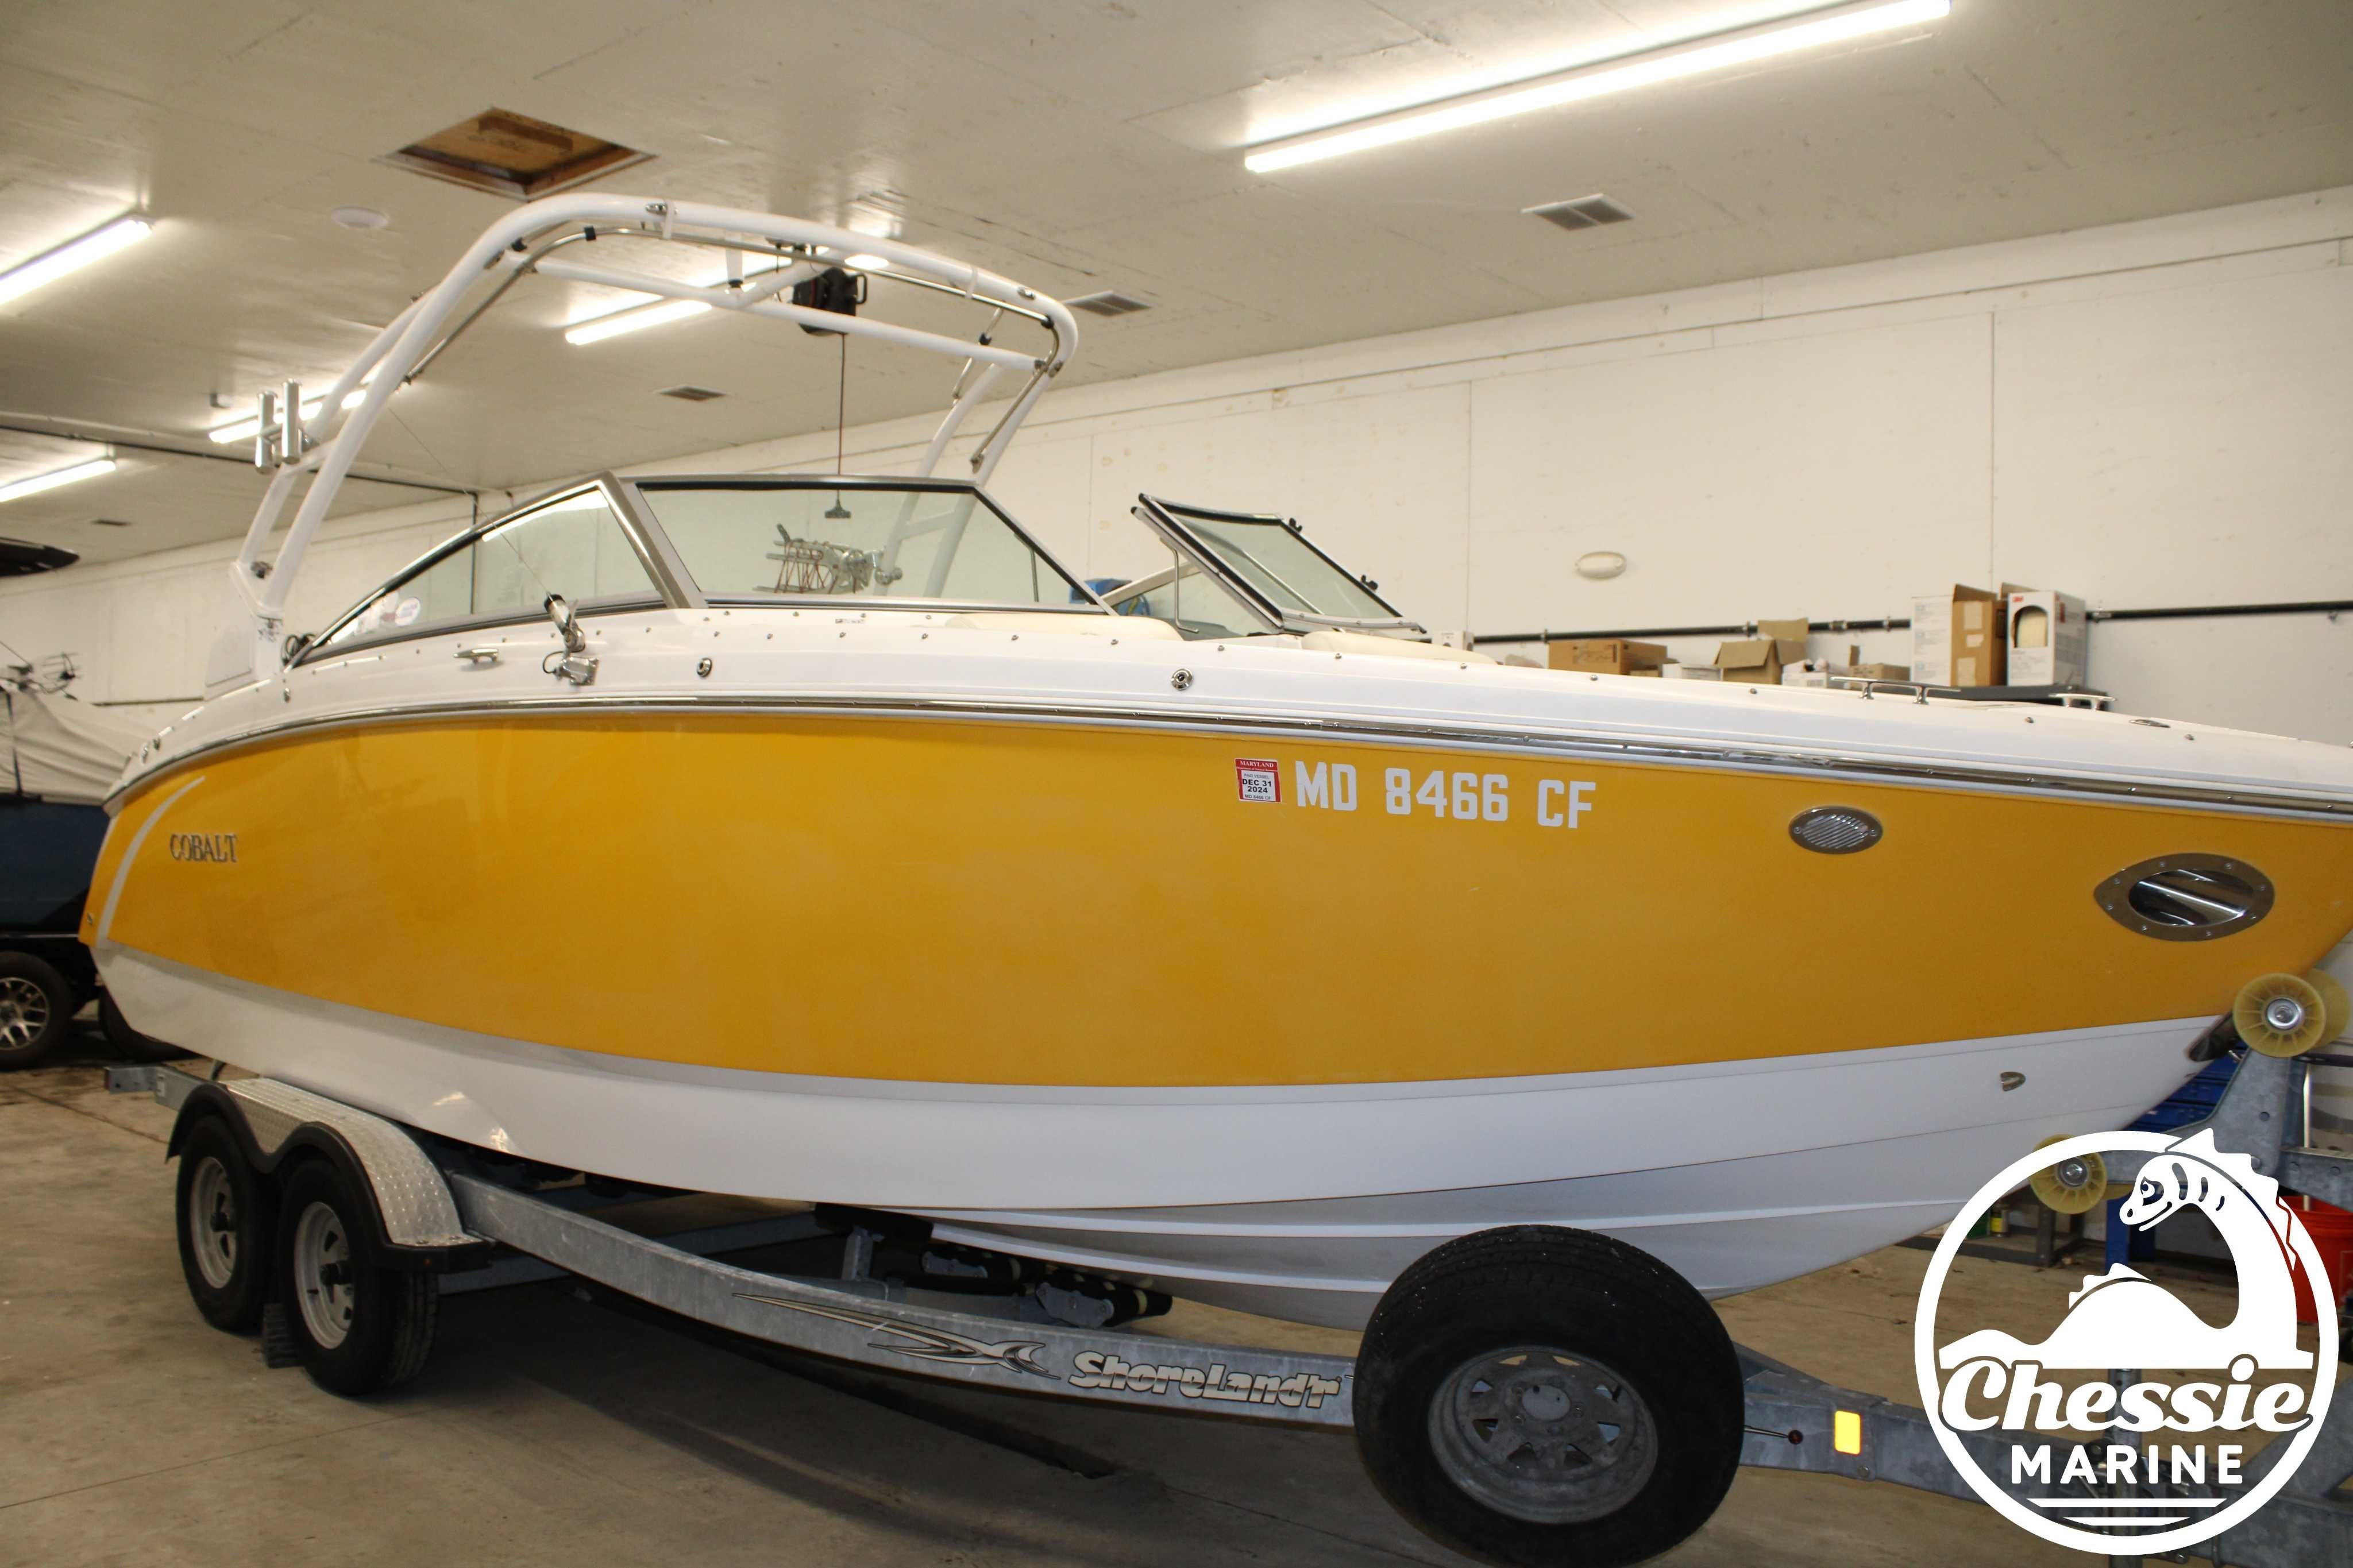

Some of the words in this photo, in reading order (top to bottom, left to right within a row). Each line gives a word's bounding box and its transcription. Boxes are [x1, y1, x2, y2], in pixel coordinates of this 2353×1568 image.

[1295, 761, 1356, 810] MD
[1385, 768, 1508, 821] 8466
[1537, 779, 1596, 828] CF
[169, 833, 237, 863] COBALT
